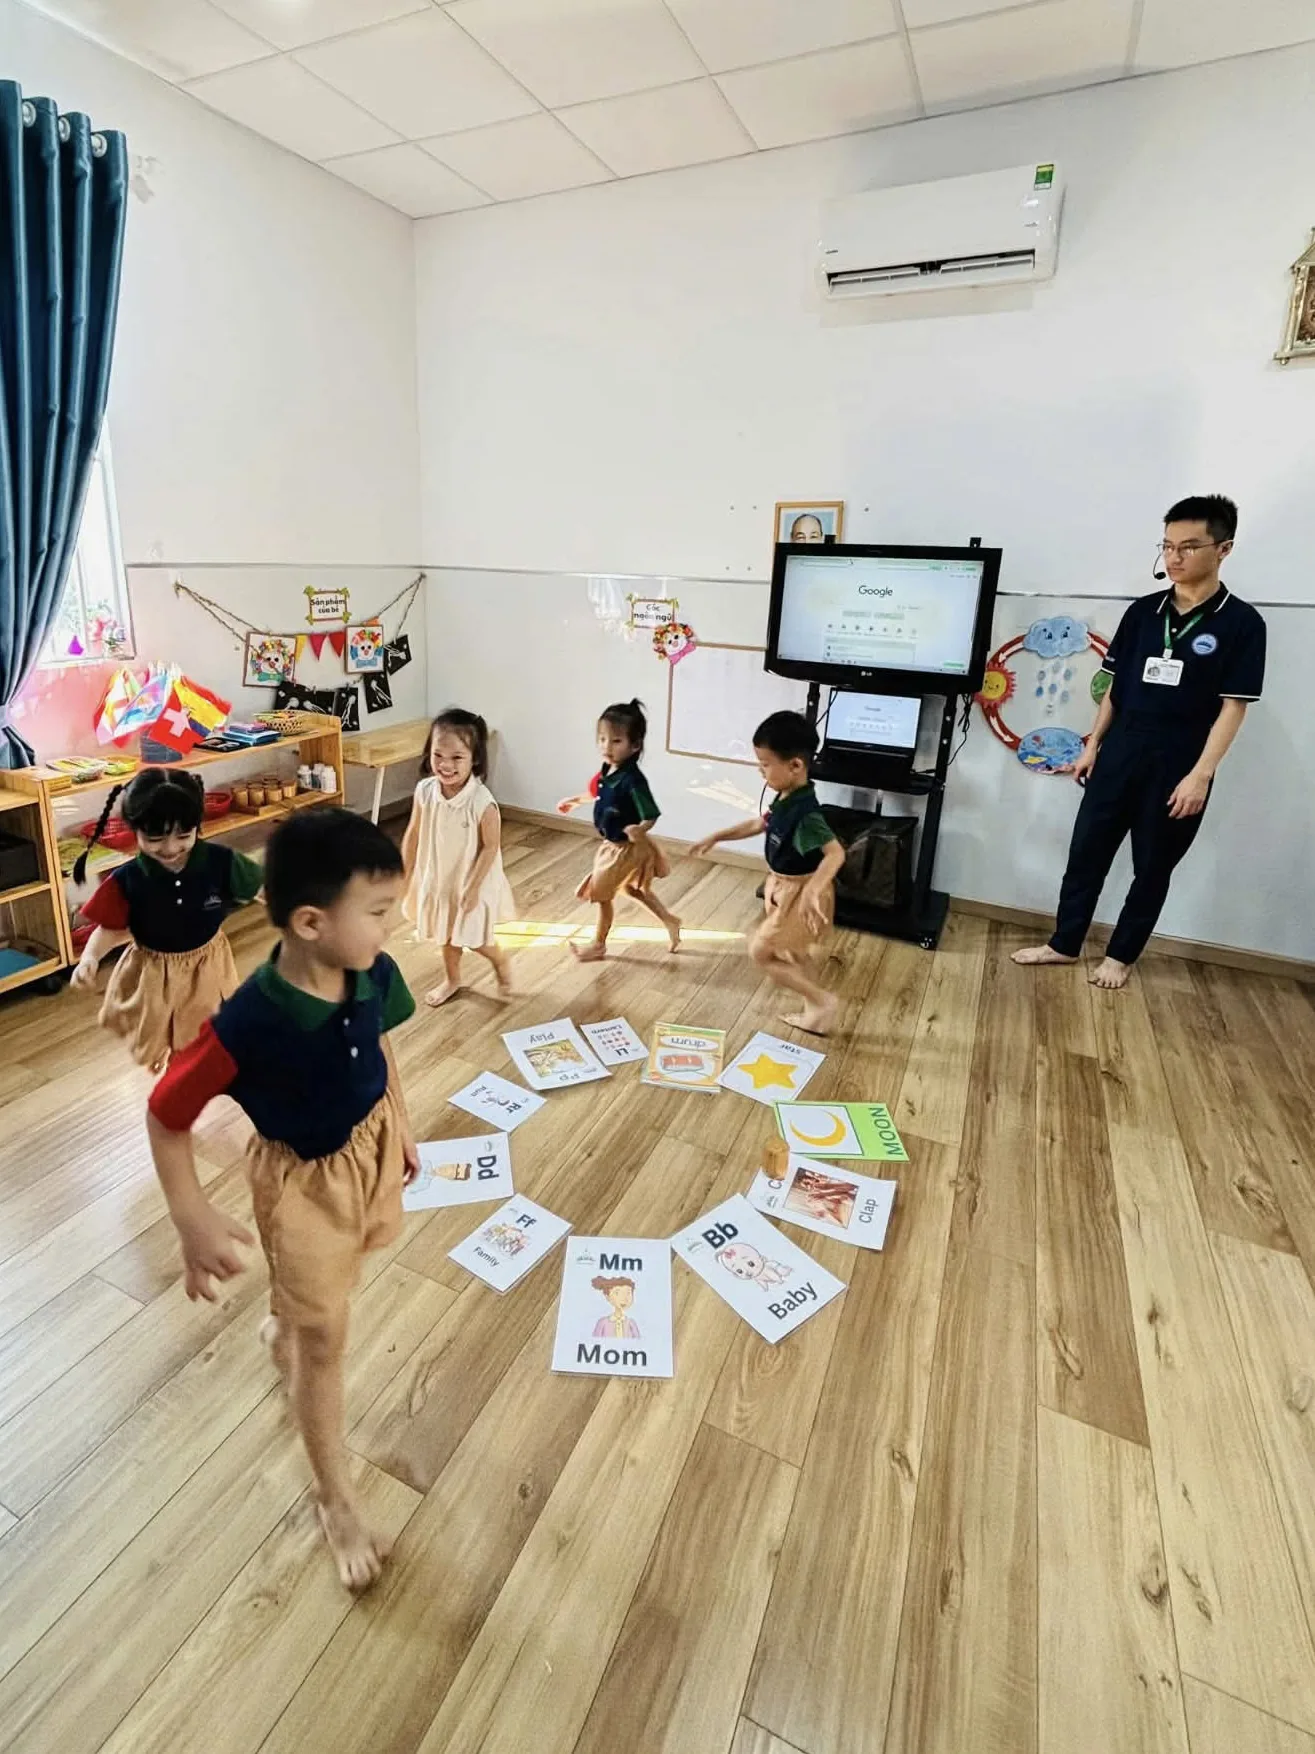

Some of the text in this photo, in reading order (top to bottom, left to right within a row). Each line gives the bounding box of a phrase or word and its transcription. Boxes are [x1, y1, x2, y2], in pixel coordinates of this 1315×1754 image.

[858, 585, 893, 598] Google
[529, 1032, 555, 1044] Play
[671, 1037, 706, 1048] drum
[779, 1044, 801, 1054] star
[470, 1085, 487, 1097] Run
[506, 1102, 522, 1114] Rr
[868, 1107, 904, 1156] MOON
[477, 1155, 499, 1180] Dd
[858, 1198, 879, 1224] Clap
[515, 1214, 537, 1229] Ff
[702, 1221, 739, 1249] Bb
[472, 1246, 500, 1268] Family
[599, 1252, 643, 1272] Mm
[767, 1281, 818, 1320] Baby
[576, 1343, 647, 1367] Mom
